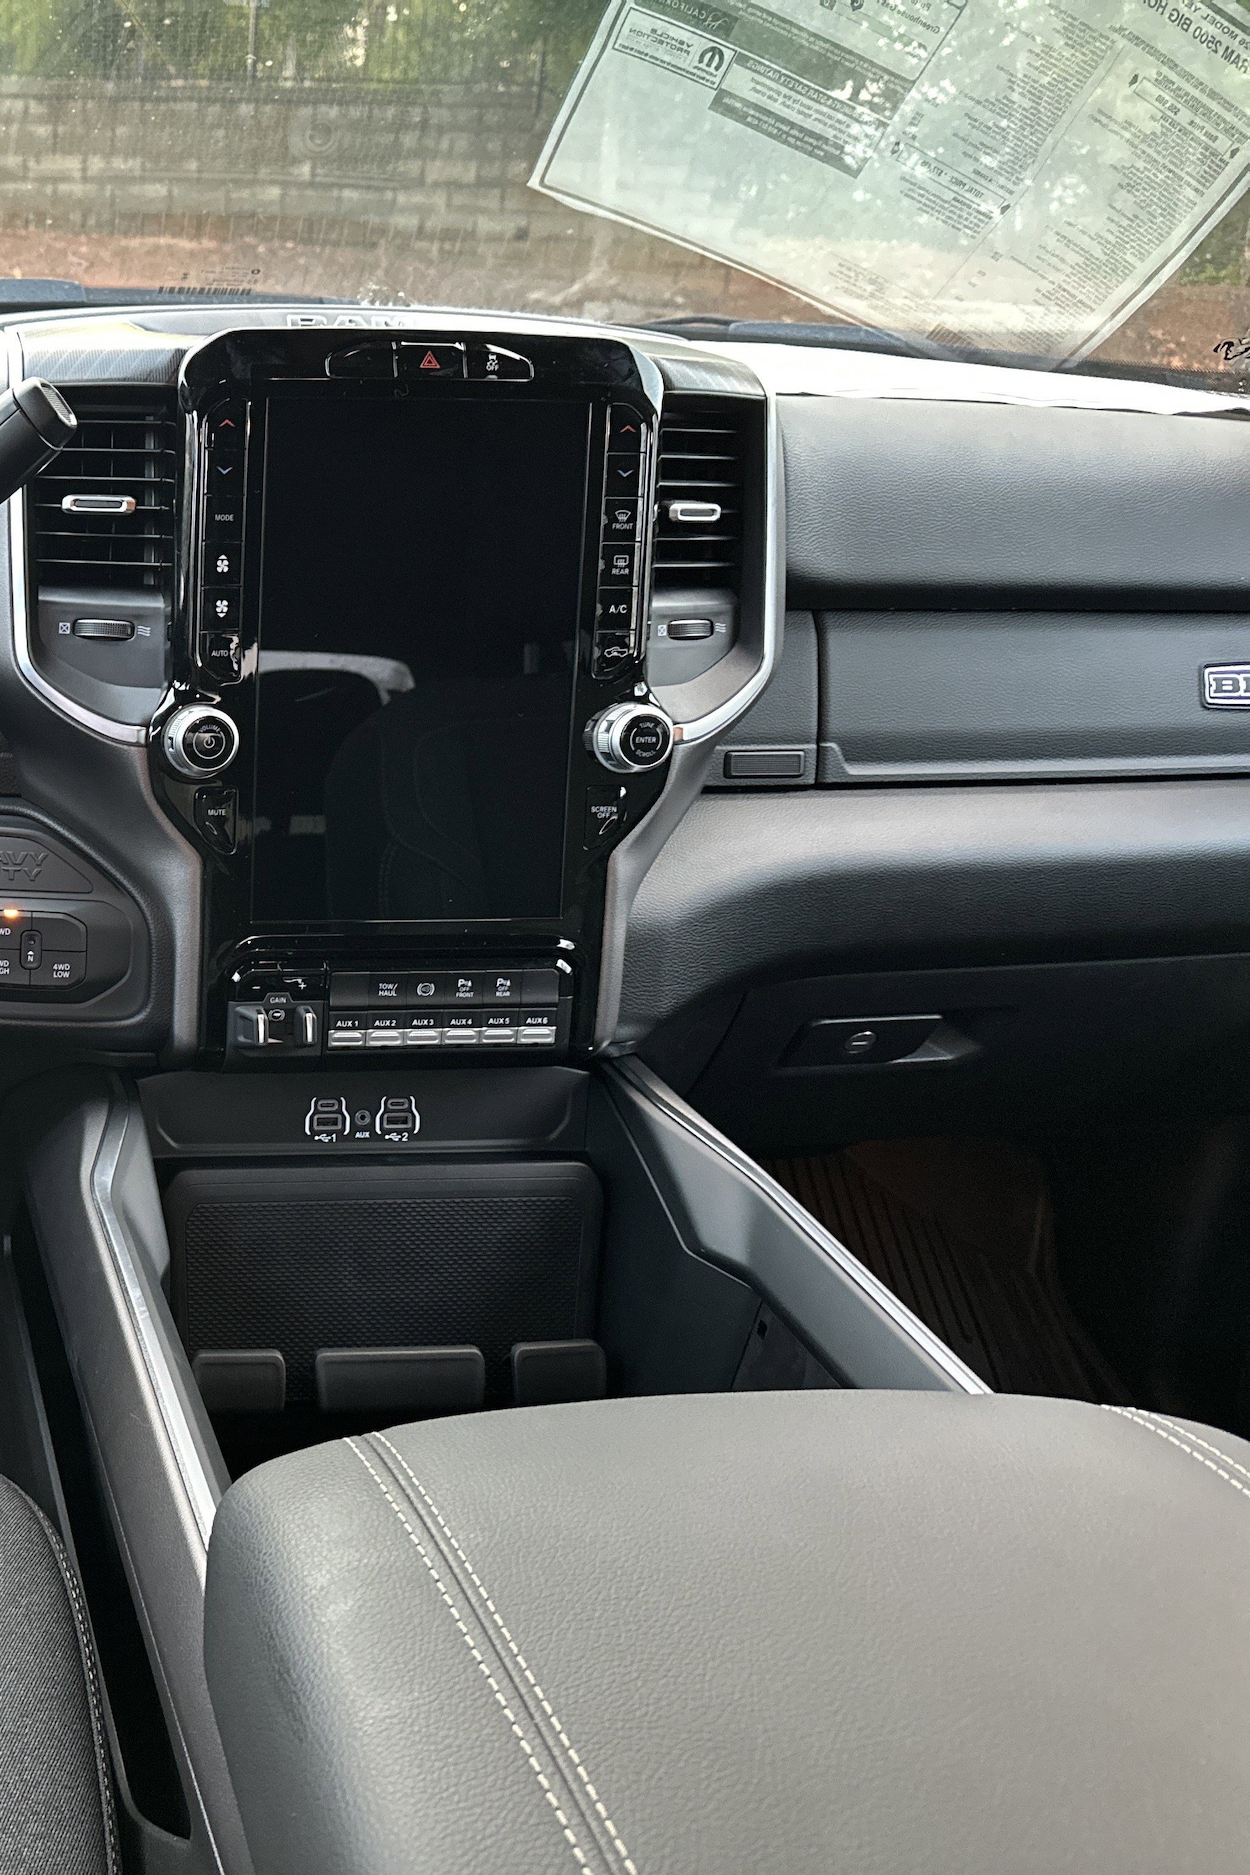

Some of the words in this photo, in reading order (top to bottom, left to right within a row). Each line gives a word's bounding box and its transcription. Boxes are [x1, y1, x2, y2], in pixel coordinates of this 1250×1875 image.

[214, 513, 234, 521] MODE
[608, 604, 628, 614] A/C
[635, 736, 657, 744] ENTER
[53, 963, 70, 971] 4WD
[53, 970, 70, 978] LOW
[378, 983, 398, 991] TOW/
[378, 989, 397, 997] HAUL
[331, 1133, 336, 1142] 1
[401, 1132, 409, 1141] 2
